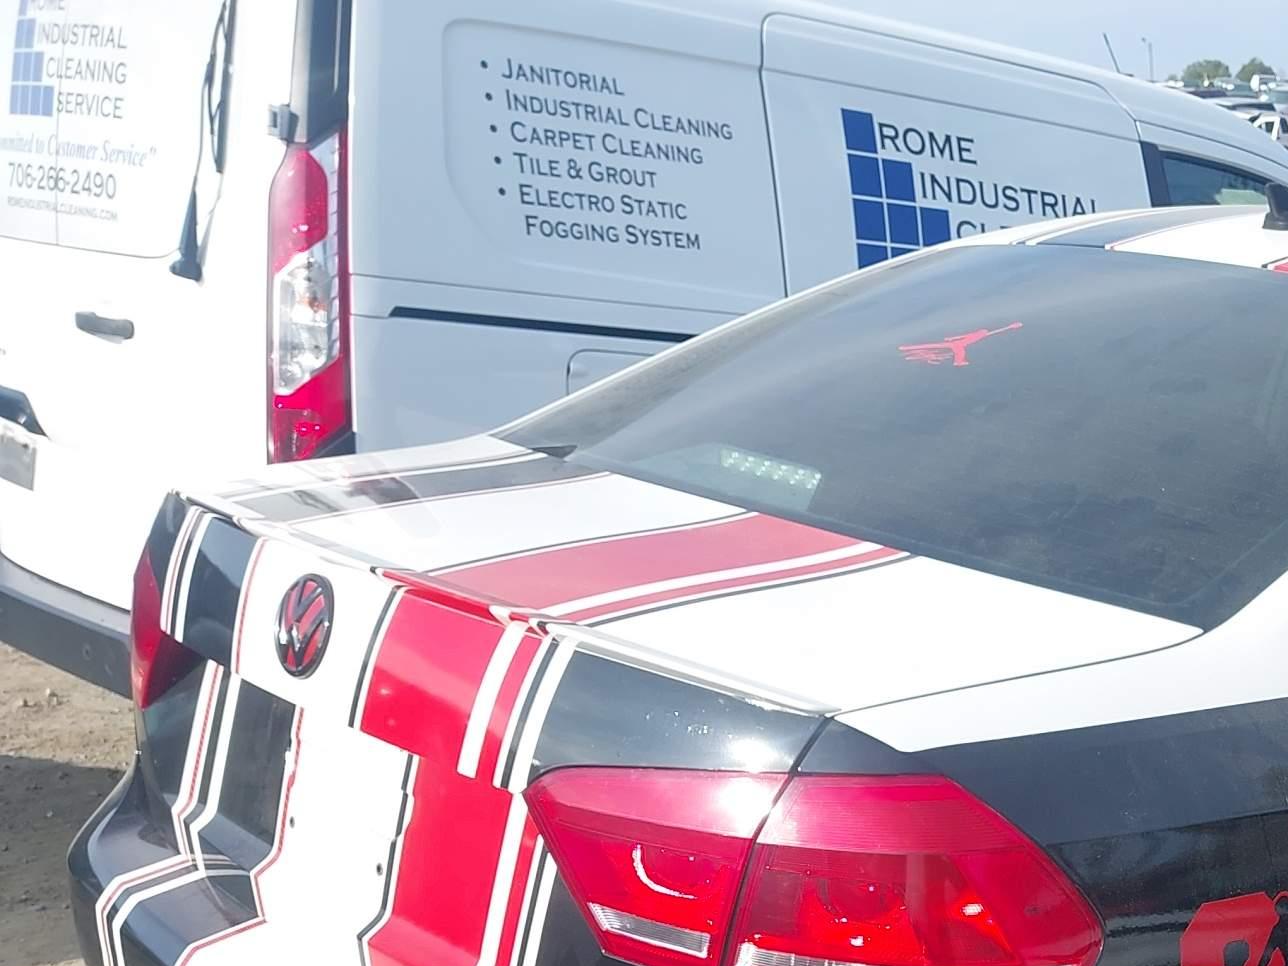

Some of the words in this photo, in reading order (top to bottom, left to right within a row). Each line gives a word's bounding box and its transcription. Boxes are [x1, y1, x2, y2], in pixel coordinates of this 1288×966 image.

[37, 22, 128, 50] INDUSTRIAL
[46, 56, 128, 84] CLEANING
[501, 57, 626, 96] JANITORIAL
[56, 91, 125, 119] SERVICE
[505, 88, 631, 127] INDUSTRIAL
[633, 107, 734, 140] CLEANING
[510, 120, 596, 152] CARPET
[601, 132, 704, 165] CLEANING
[877, 121, 978, 166] ROME
[8, 161, 118, 200] 706-266-2490
[513, 152, 562, 177] TILE
[566, 157, 583, 181] &
[587, 160, 658, 188] GROUT
[518, 182, 616, 214] ELECTRO
[620, 194, 688, 221] STATIC
[524, 214, 620, 244] FOGGING
[624, 224, 702, 251] SYSTEM
